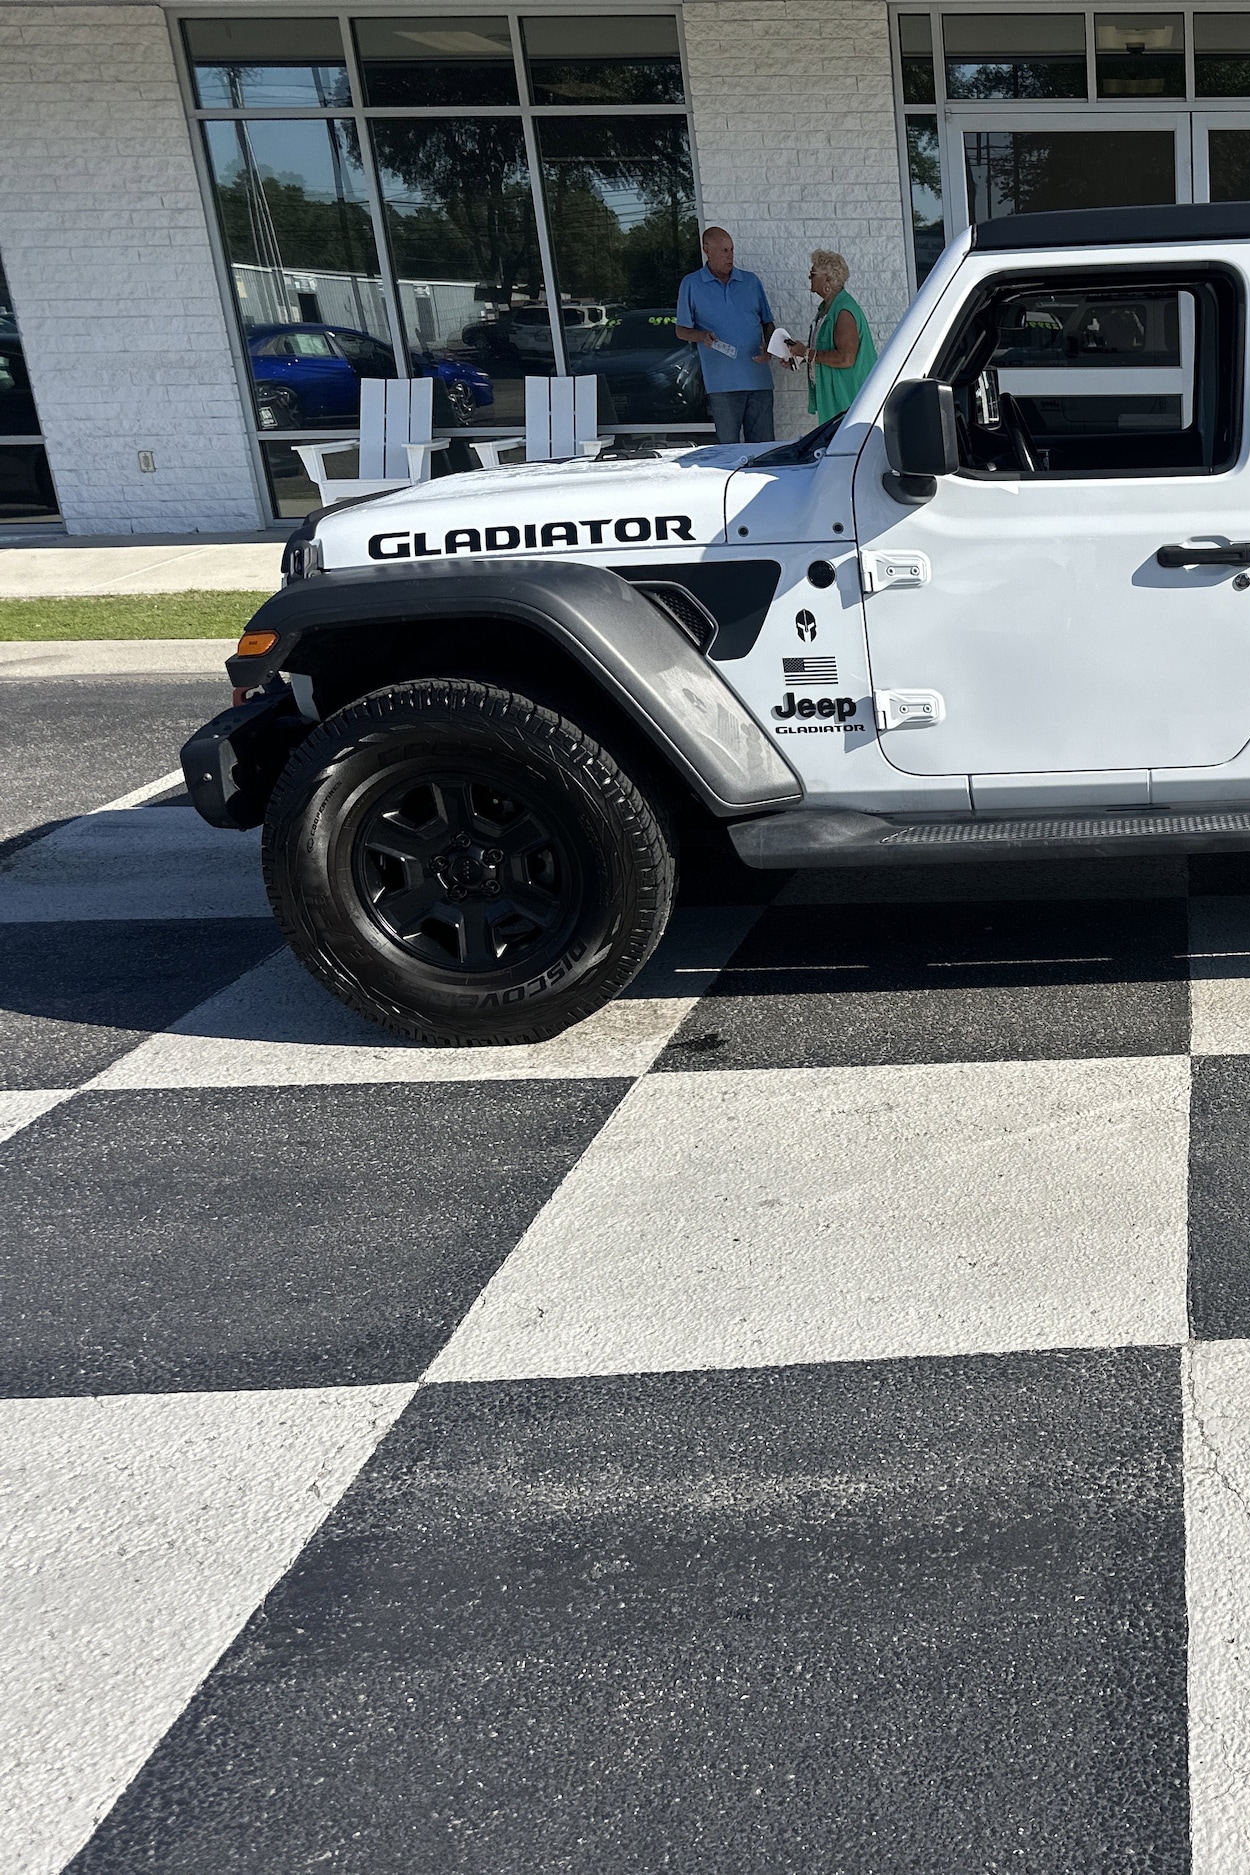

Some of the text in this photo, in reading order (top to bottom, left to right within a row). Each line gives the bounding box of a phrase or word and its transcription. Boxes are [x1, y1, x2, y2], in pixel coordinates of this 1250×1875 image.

[368, 515, 697, 560] GLADIATOR
[770, 692, 857, 723] Jeep
[775, 724, 866, 735] GLADIATOR
